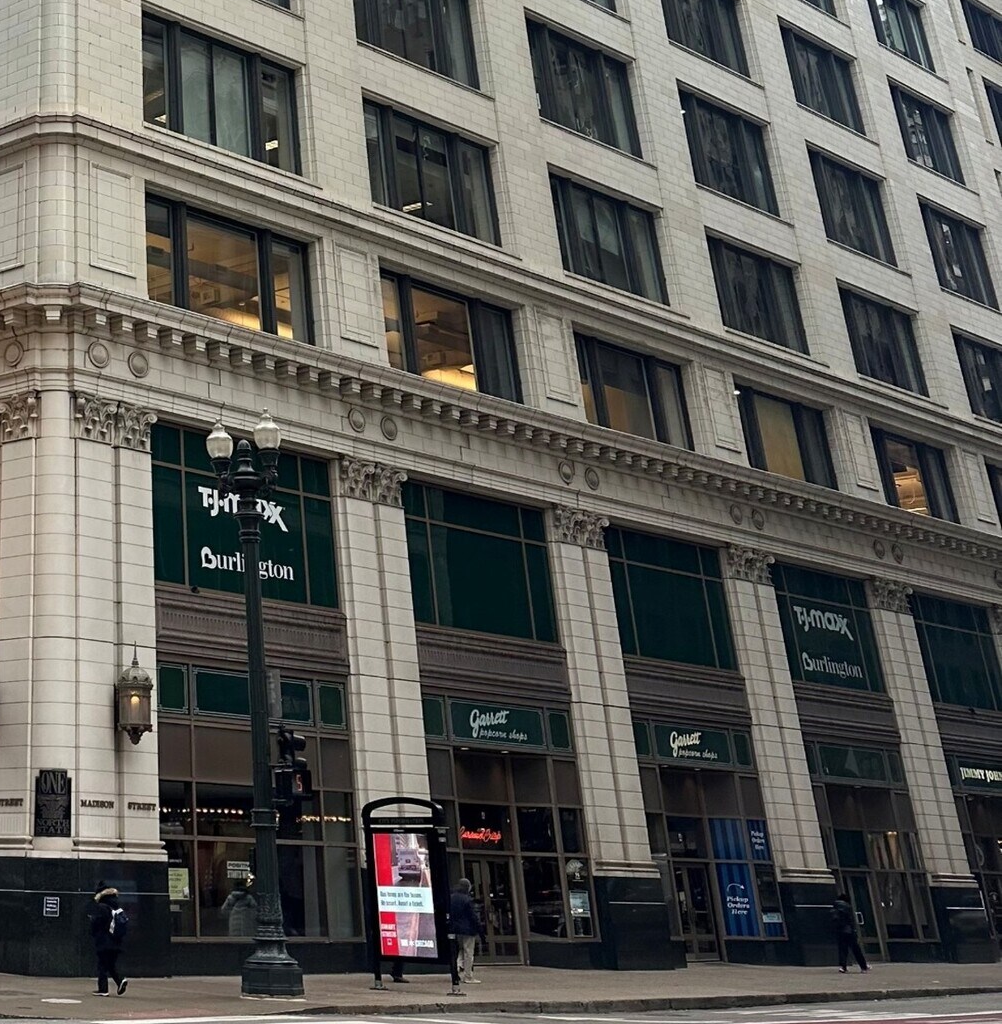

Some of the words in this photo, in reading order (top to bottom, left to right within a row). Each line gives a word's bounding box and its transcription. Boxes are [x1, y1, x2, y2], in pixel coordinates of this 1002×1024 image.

[201, 546, 294, 580] Burligton
[802, 652, 863, 679] Burlington
[470, 708, 510, 738] Garrett
[479, 728, 507, 740] popcorn
[508, 729, 527, 741] shops
[670, 731, 702, 758] Garrett
[678, 748, 701, 758] popcorn
[702, 748, 718, 759] shops
[959, 767, 985, 780] JIMMY
[41, 771, 67, 794] ONE
[80, 799, 114, 809] MADISON
[127, 802, 156, 811] STREET
[36, 818, 69, 826] NORTH
[36, 826, 69, 834] STATE
[726, 896, 749, 904] Pickup
